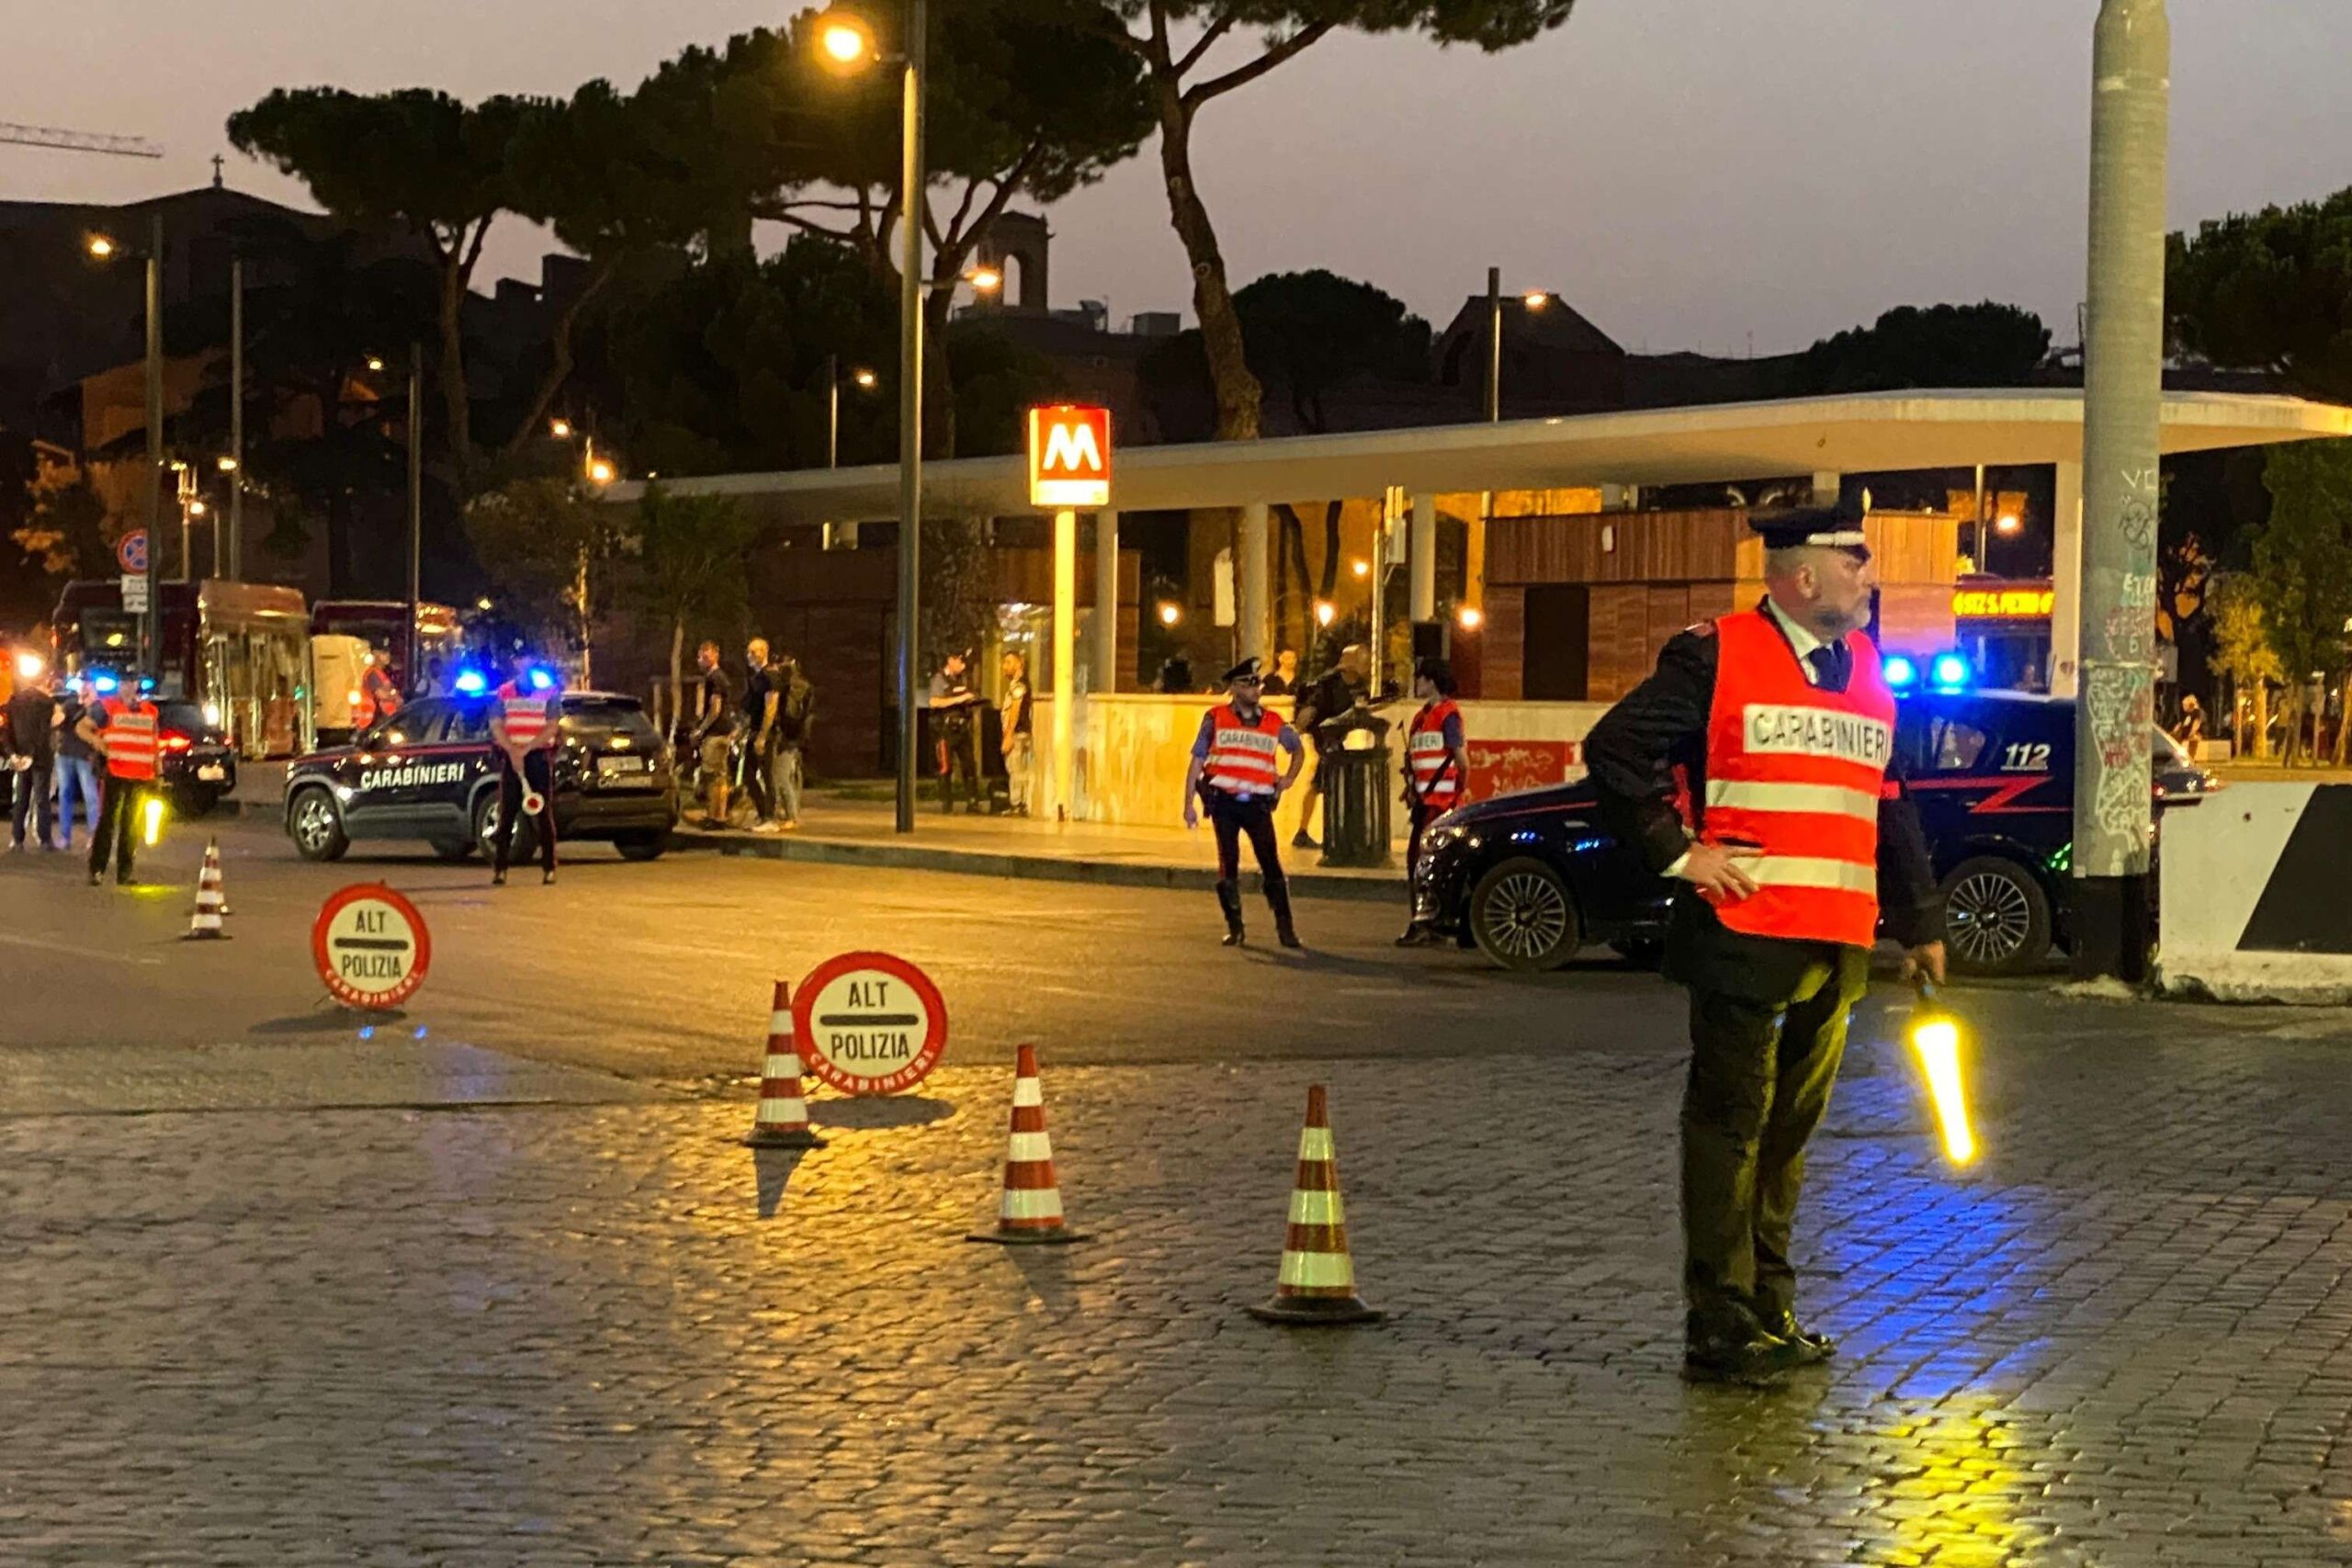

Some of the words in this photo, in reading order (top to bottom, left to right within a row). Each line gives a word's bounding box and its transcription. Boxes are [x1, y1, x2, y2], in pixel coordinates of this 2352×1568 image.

[1042, 423, 1102, 471] M
[1753, 710, 1889, 762] CARABINIERI
[2005, 742, 2051, 768] 112
[360, 762, 465, 792] CARABINIERI
[356, 909, 386, 933] ALT
[342, 953, 401, 978] POLIZIA
[848, 980, 888, 1008] ALT
[831, 1032, 910, 1060] POLIZIA
[809, 1049, 934, 1091] CARABINIERI
